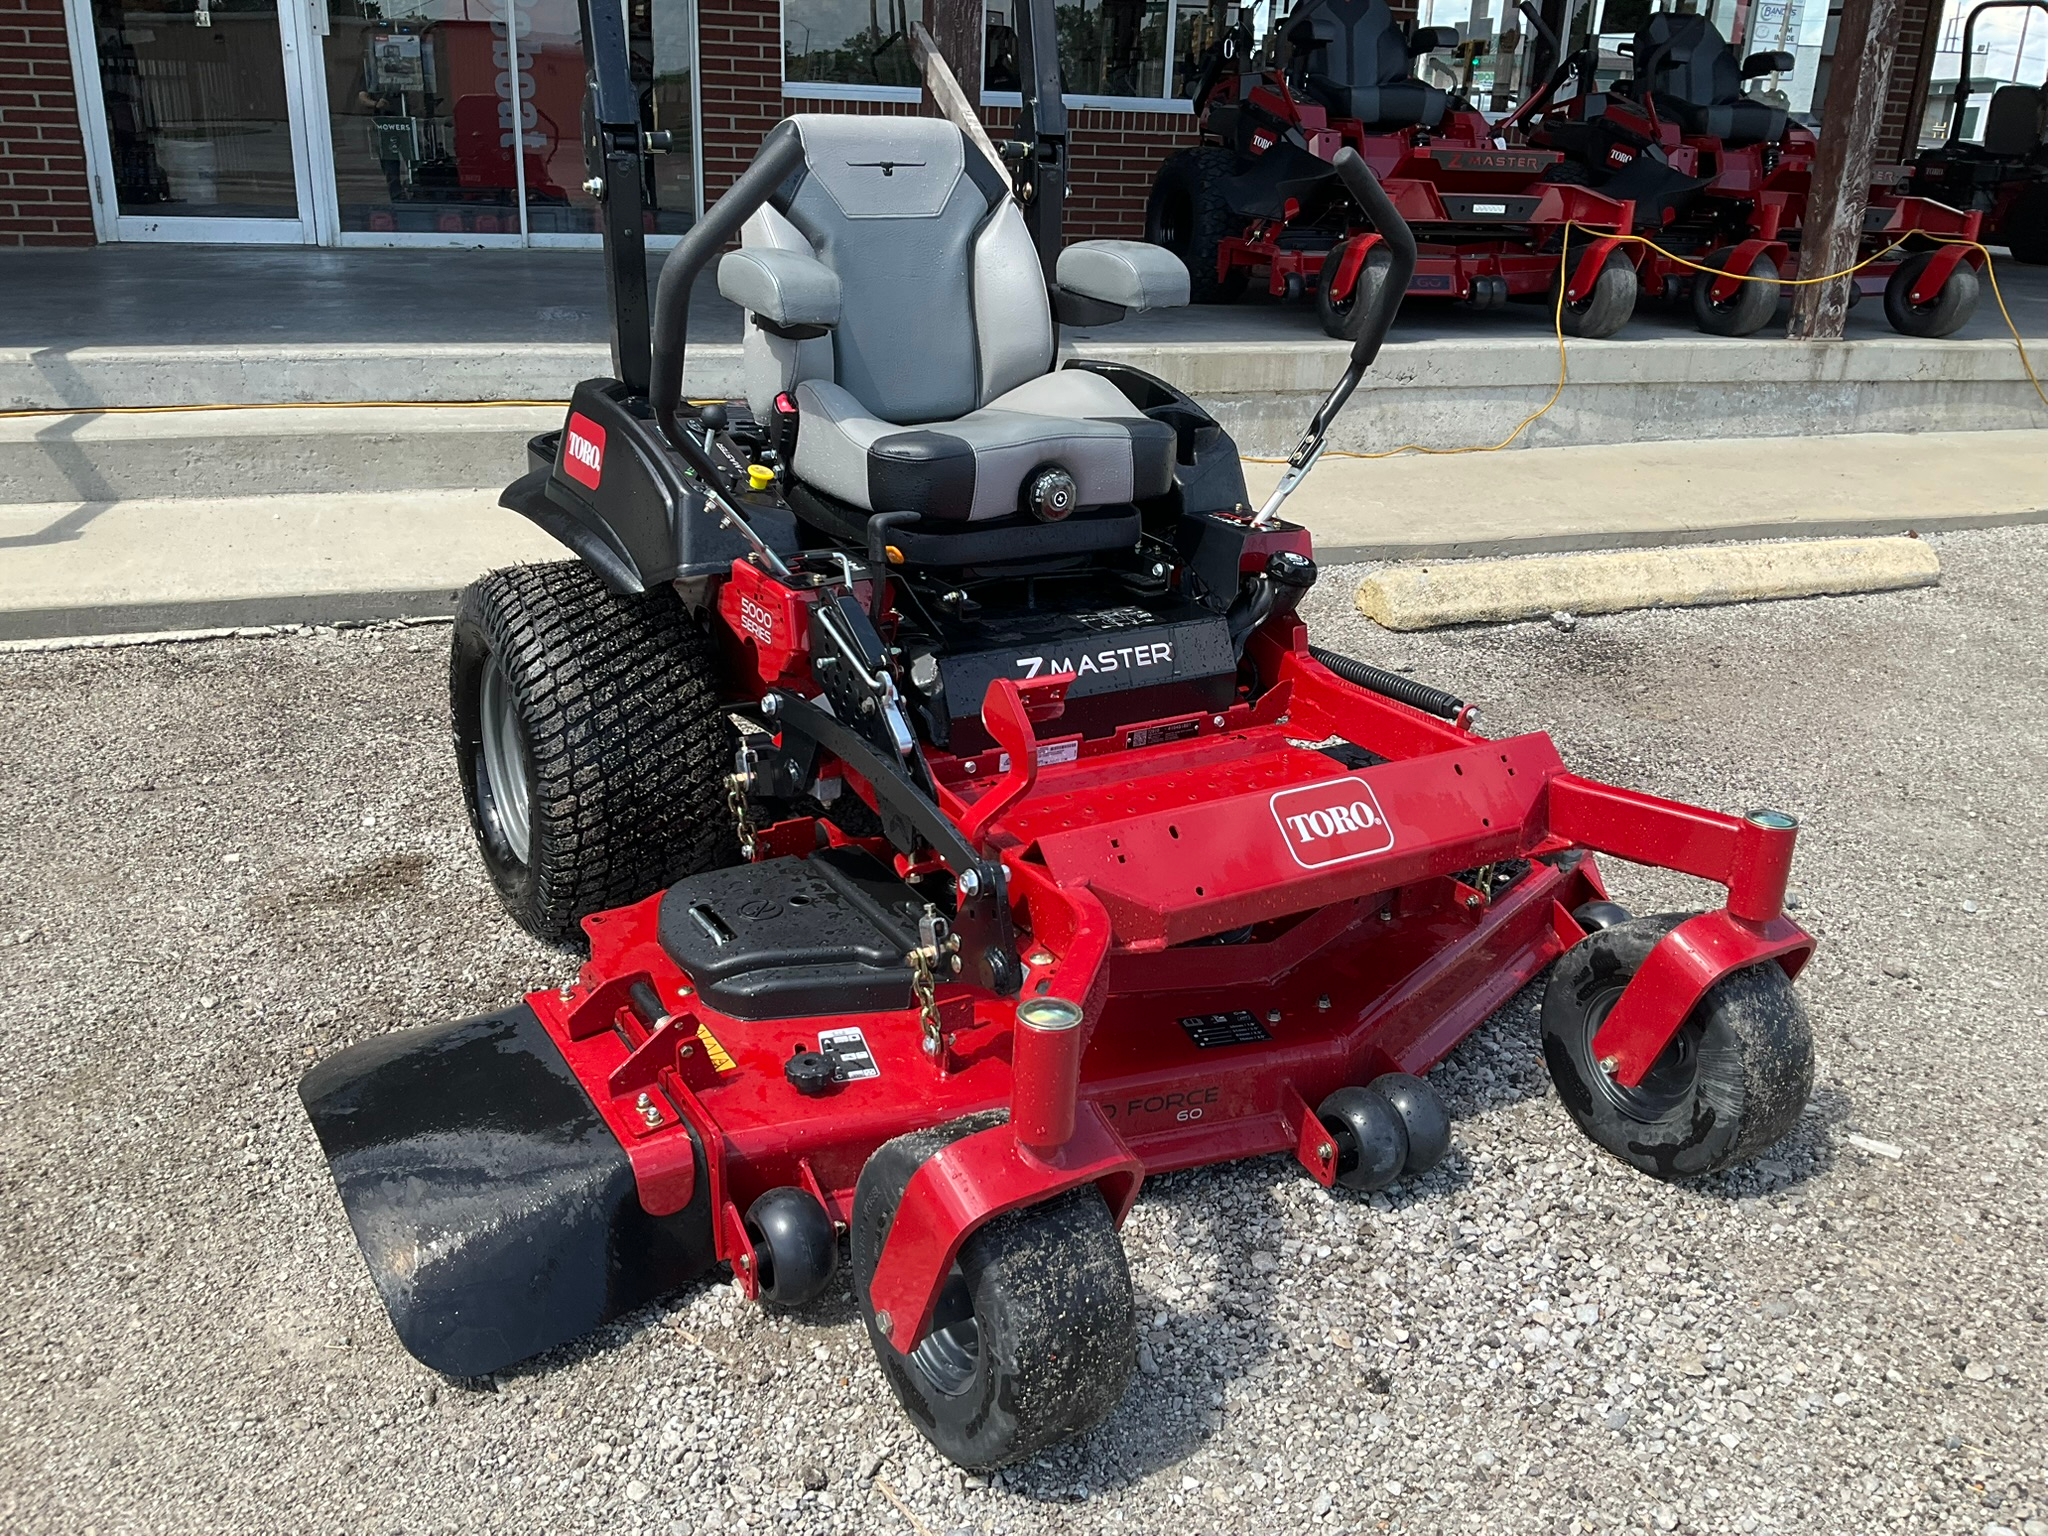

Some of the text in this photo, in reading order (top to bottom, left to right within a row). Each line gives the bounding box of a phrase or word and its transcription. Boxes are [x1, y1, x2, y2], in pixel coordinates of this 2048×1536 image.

[1447, 153, 1538, 170] Z MASTER
[568, 431, 601, 472] TORO
[741, 597, 772, 629] 5000
[741, 614, 772, 645] SERIES
[1051, 642, 1173, 675] MASTER
[1286, 801, 1378, 843] TORO
[1128, 1087, 1219, 1116] FORCE
[1176, 1108, 1203, 1121] 60
